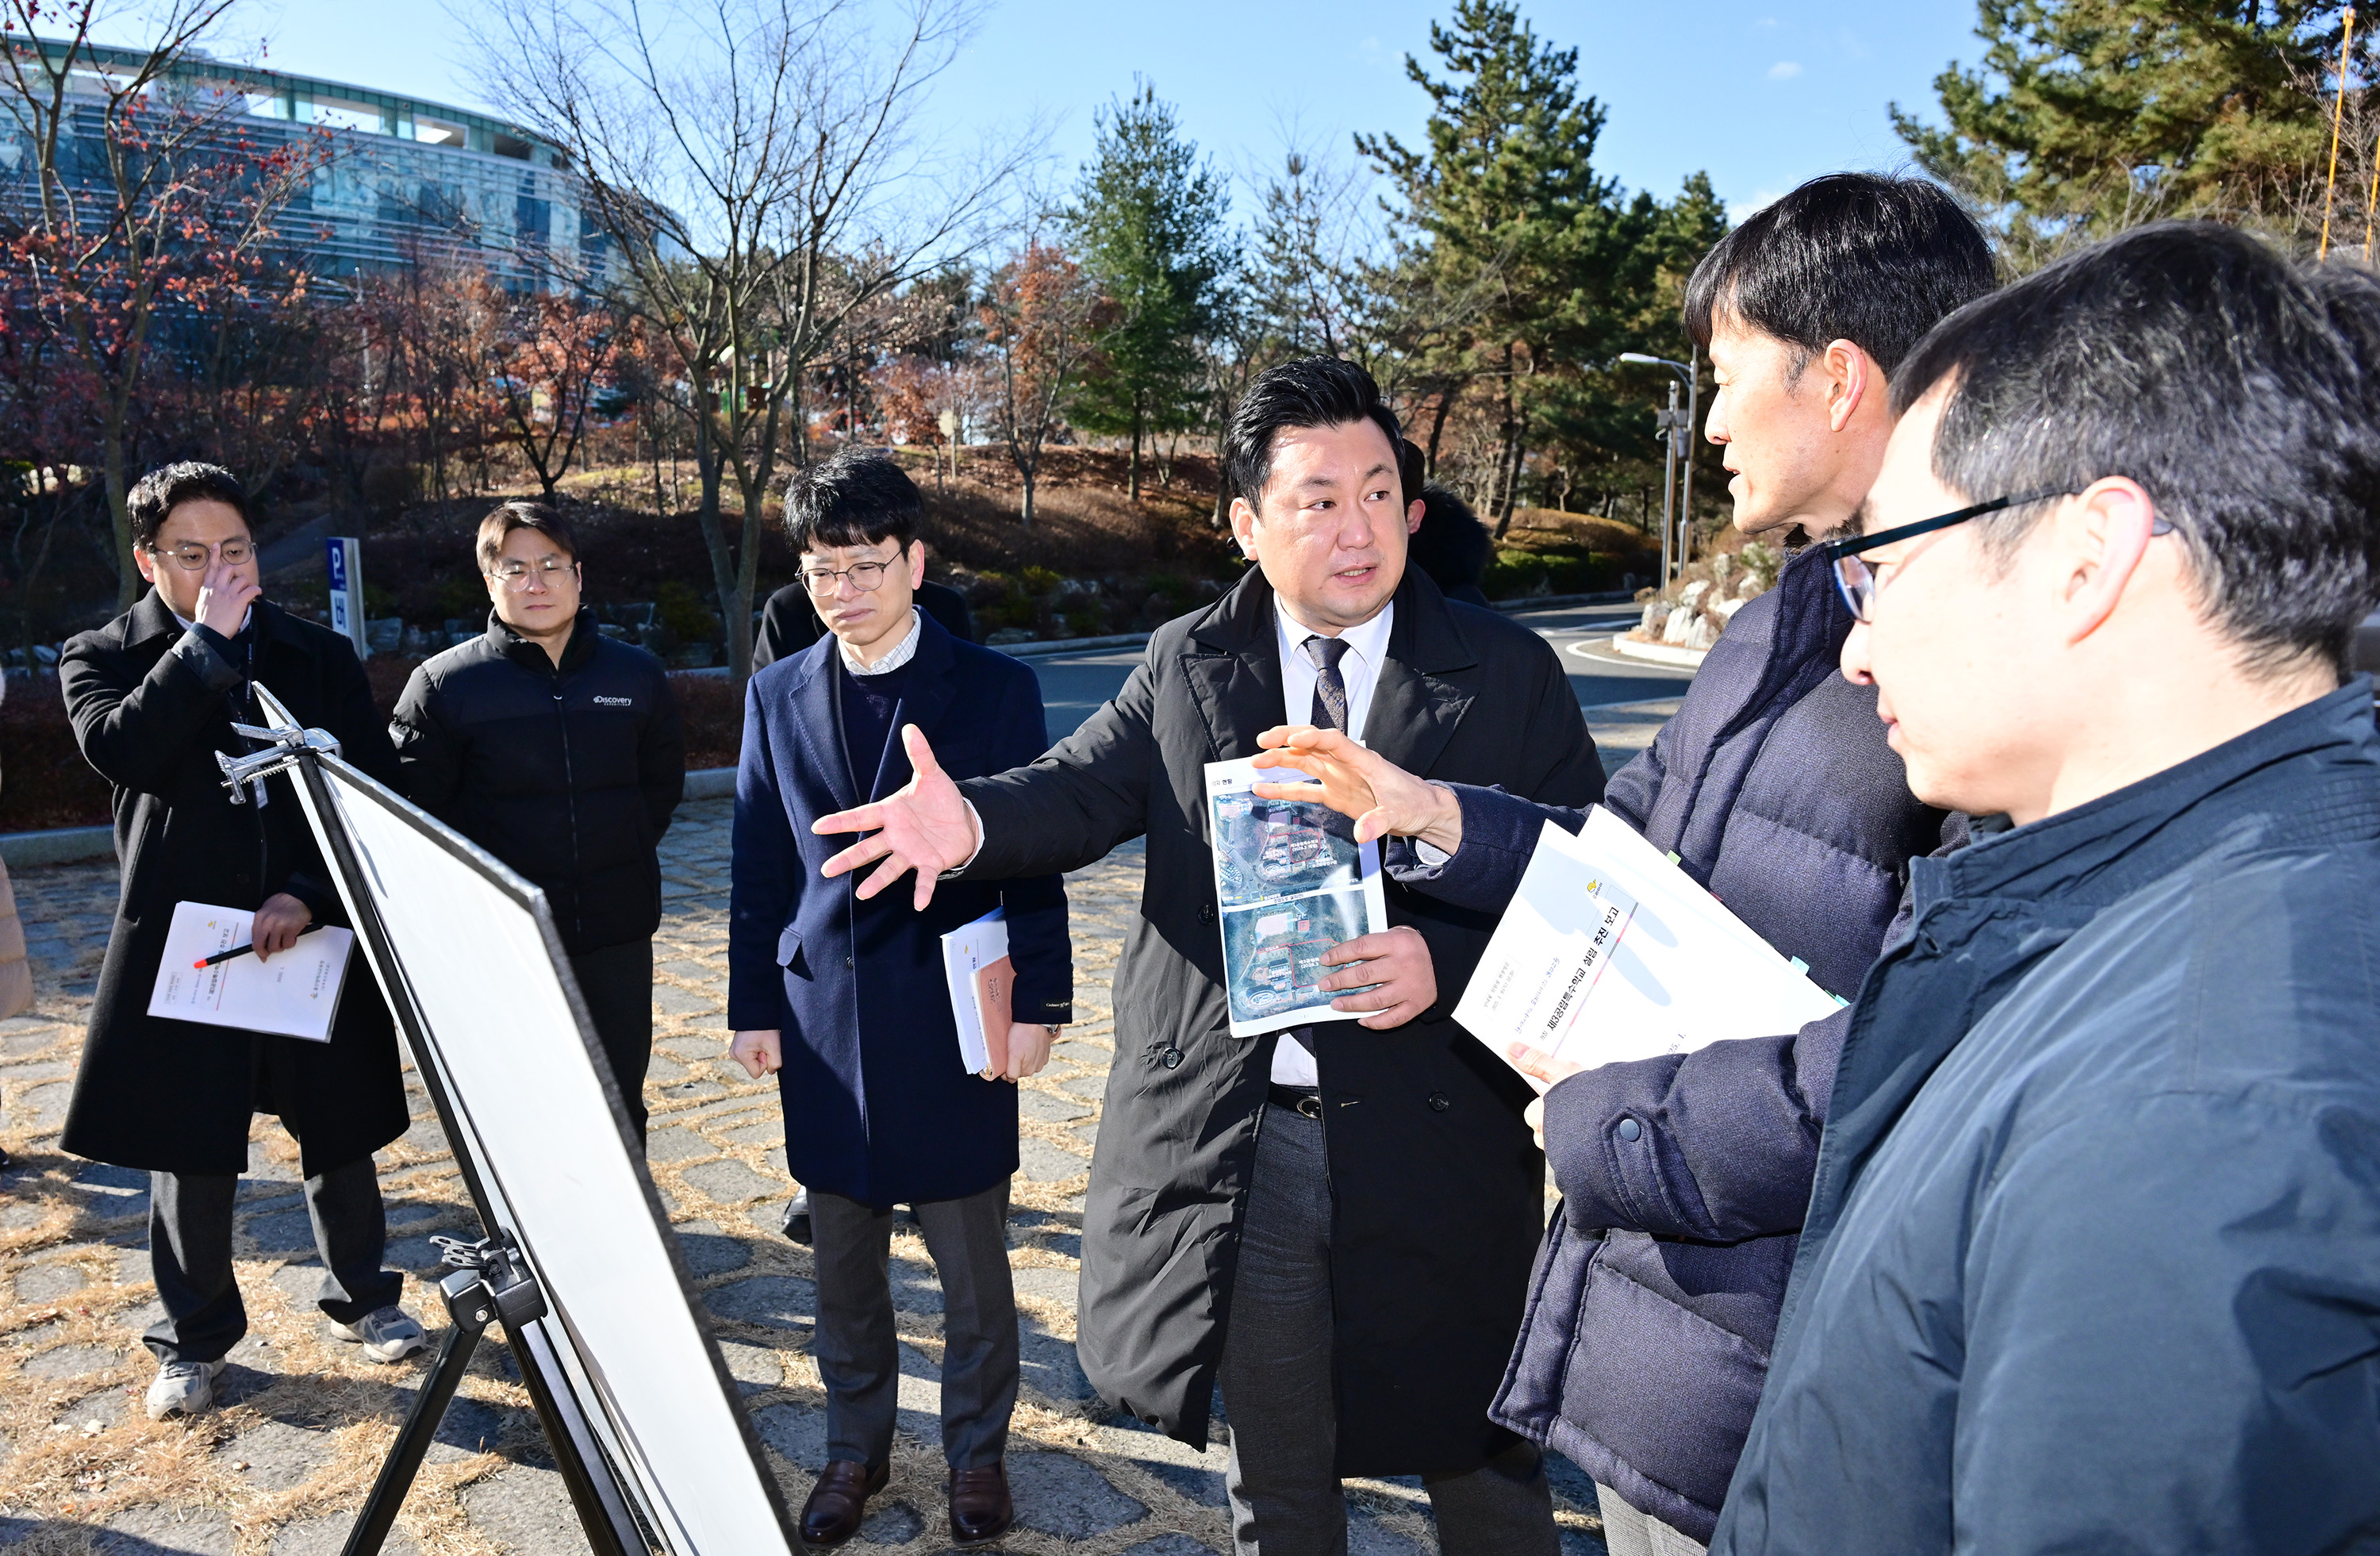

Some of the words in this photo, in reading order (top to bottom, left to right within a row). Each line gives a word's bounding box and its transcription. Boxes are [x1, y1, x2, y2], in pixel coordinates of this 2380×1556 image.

[332, 547, 341, 578] P
[593, 696, 631, 705] Discovery
[1547, 967, 1587, 1032] 제3공립특수학교
[1583, 947, 1598, 967] 설립
[1593, 926, 1610, 947] 추진
[1603, 906, 1619, 927] 보고
